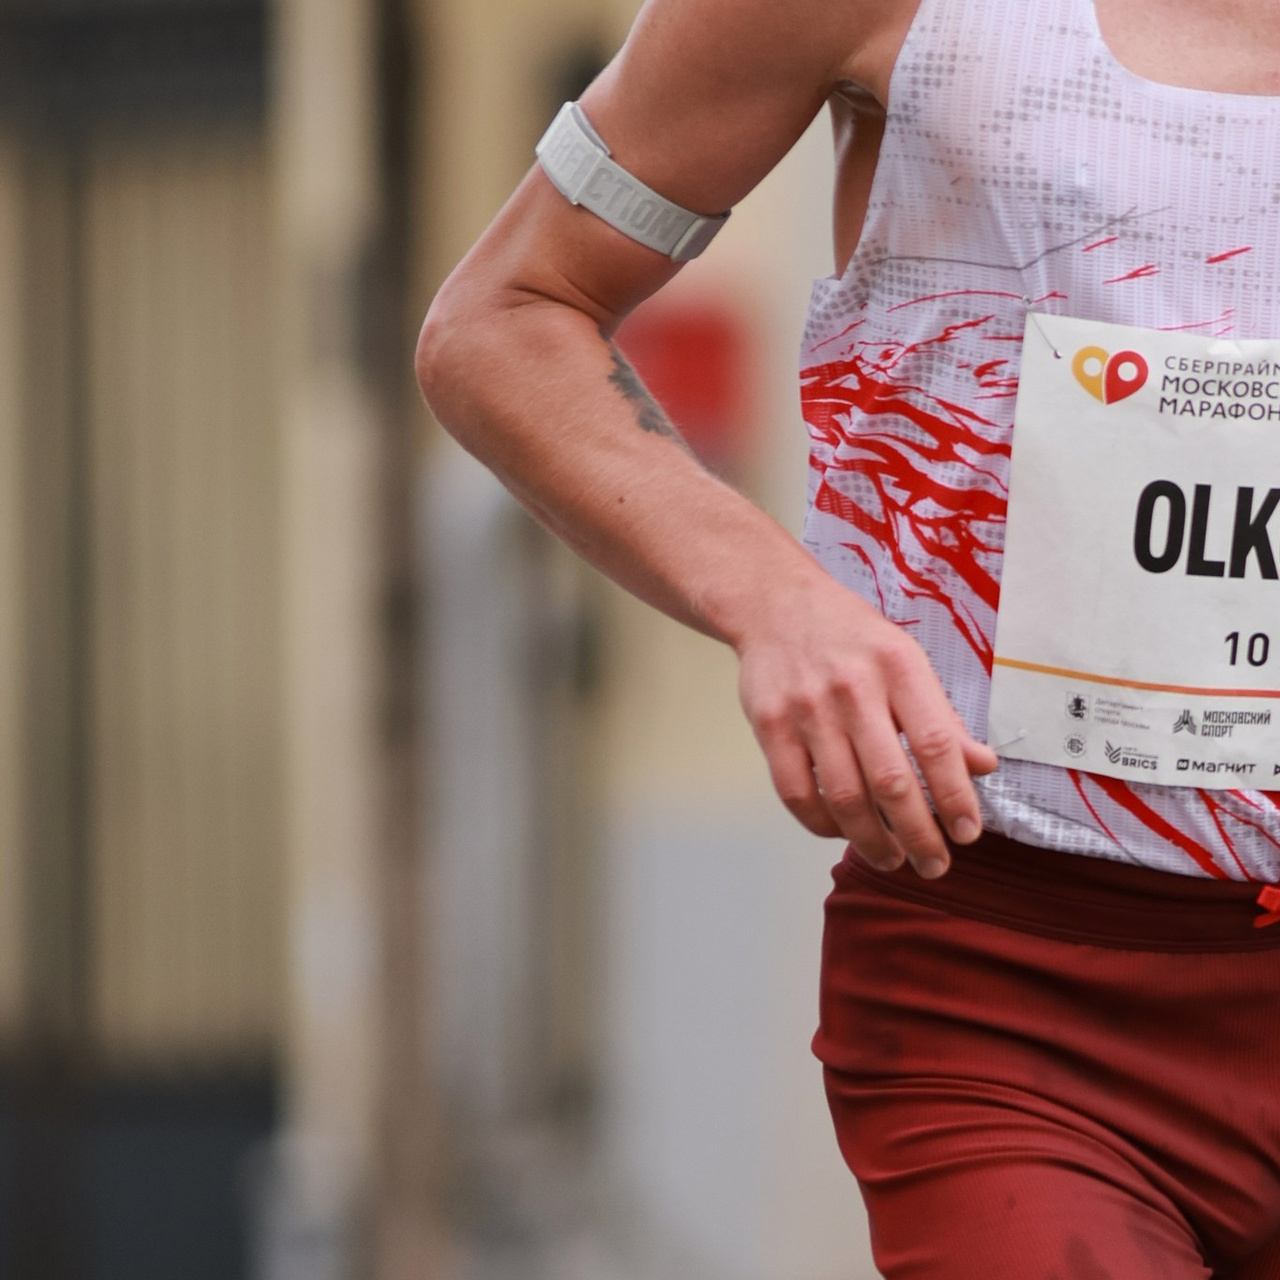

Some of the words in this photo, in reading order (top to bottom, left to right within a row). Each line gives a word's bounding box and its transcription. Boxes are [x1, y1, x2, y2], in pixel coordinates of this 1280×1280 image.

[1224, 631, 1270, 667] 10
[1202, 709, 1271, 725] МОСКОВСКИЙ
[1201, 724, 1234, 737] СПОРТ
[1121, 756, 1158, 770] BRICS
[1192, 760, 1257, 774] магнит
